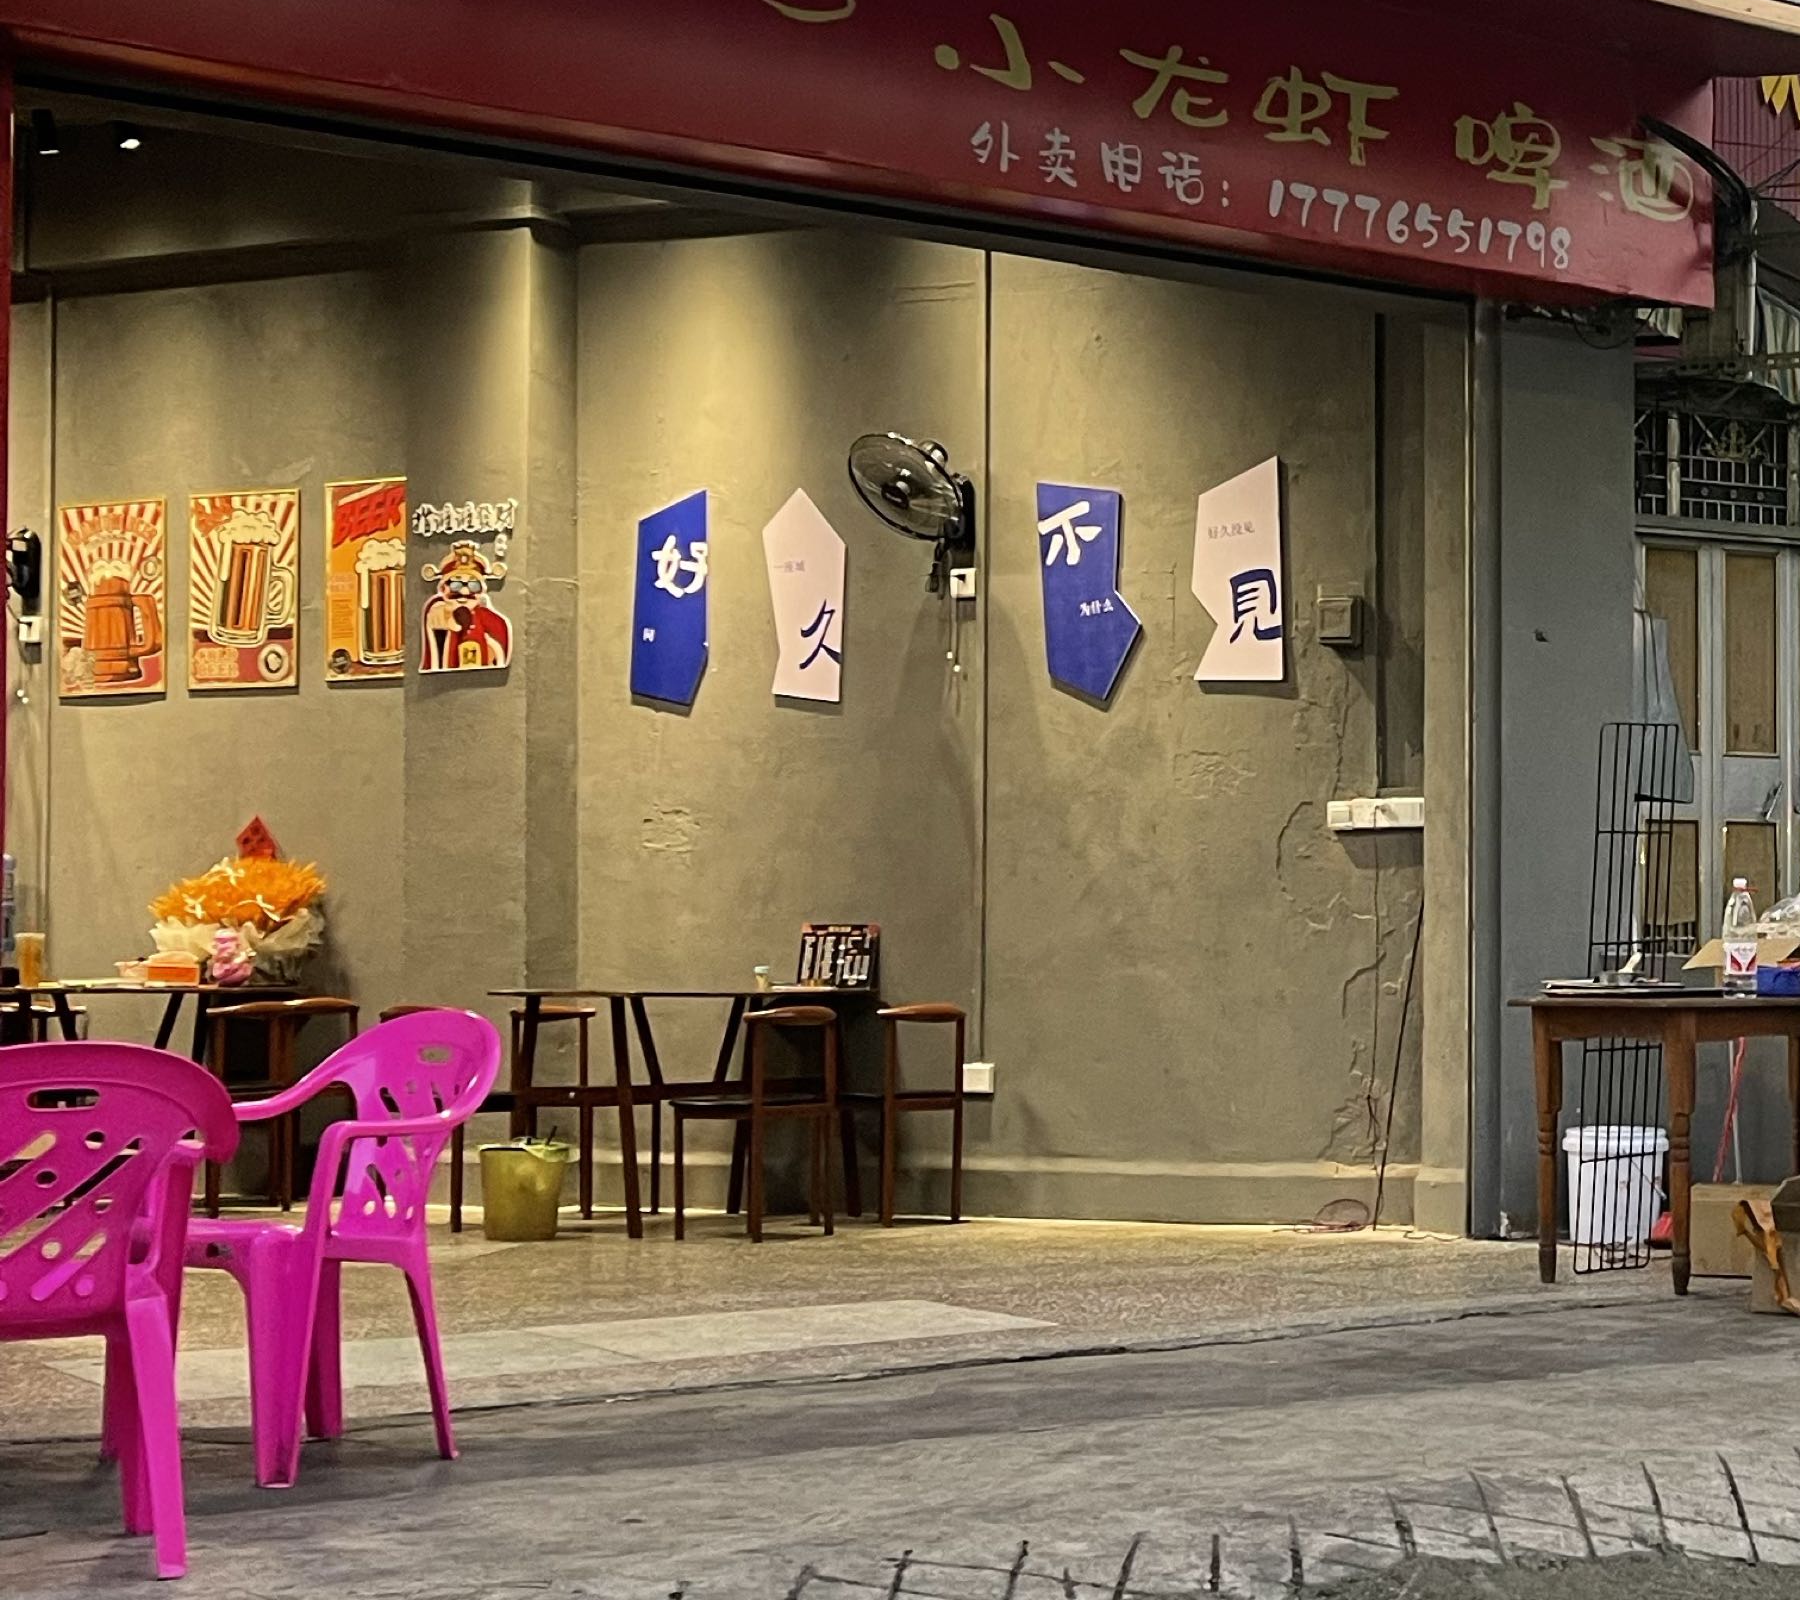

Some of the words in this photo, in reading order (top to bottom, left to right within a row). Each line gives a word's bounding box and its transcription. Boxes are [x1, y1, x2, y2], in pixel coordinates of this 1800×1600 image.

[933, 13, 1400, 167] 小龙虾
[1455, 101, 1695, 223] 啤酒
[651, 534, 708, 598] 好
[1037, 500, 1102, 566] 不
[799, 599, 842, 670] 久
